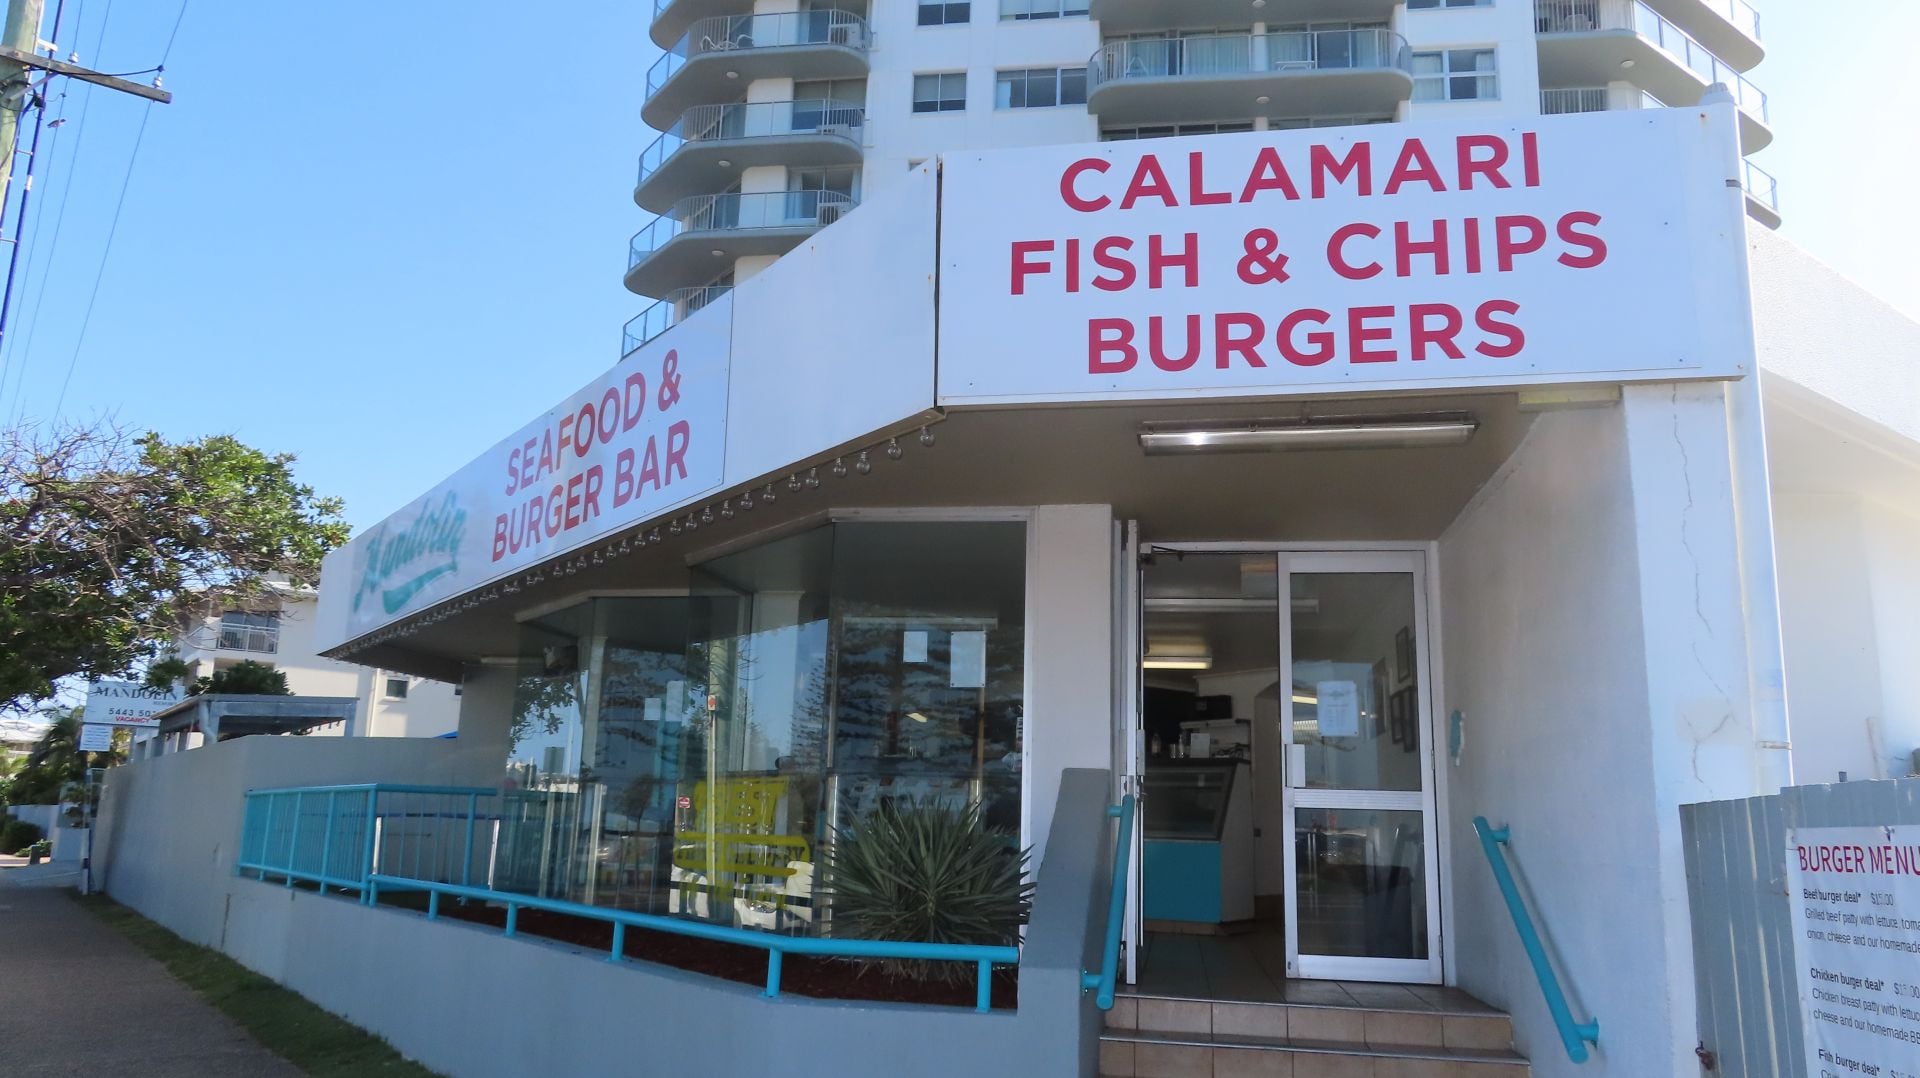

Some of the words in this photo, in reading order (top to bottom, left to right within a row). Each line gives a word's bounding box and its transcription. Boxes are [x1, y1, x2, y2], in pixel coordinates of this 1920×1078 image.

[1059, 131, 1541, 213] CALAMARI
[1011, 232, 1200, 296] FISH
[1236, 227, 1291, 286] &
[1326, 210, 1608, 281] CHIPS
[1088, 299, 1526, 375] BURGERS
[504, 371, 647, 497] SEAFOOD
[657, 348, 682, 412] &
[491, 463, 604, 563] BURGER
[612, 419, 690, 509] BAR
[108, 707, 134, 716] 5443
[1798, 845, 1866, 873] BURGER
[1868, 845, 1920, 876] MENU
[1818, 889, 1842, 904] burger
[1853, 934, 1866, 947] and
[1810, 967, 1839, 984] Chicken
[1840, 971, 1862, 989] burger
[1812, 987, 1839, 1004] Chicken
[1840, 992, 1861, 1009] breast
[1813, 1008, 1839, 1025] cheese
[1840, 1015, 1853, 1028] and
[1867, 1021, 1909, 1042] homemade
[1835, 1053, 1861, 1072] burger
